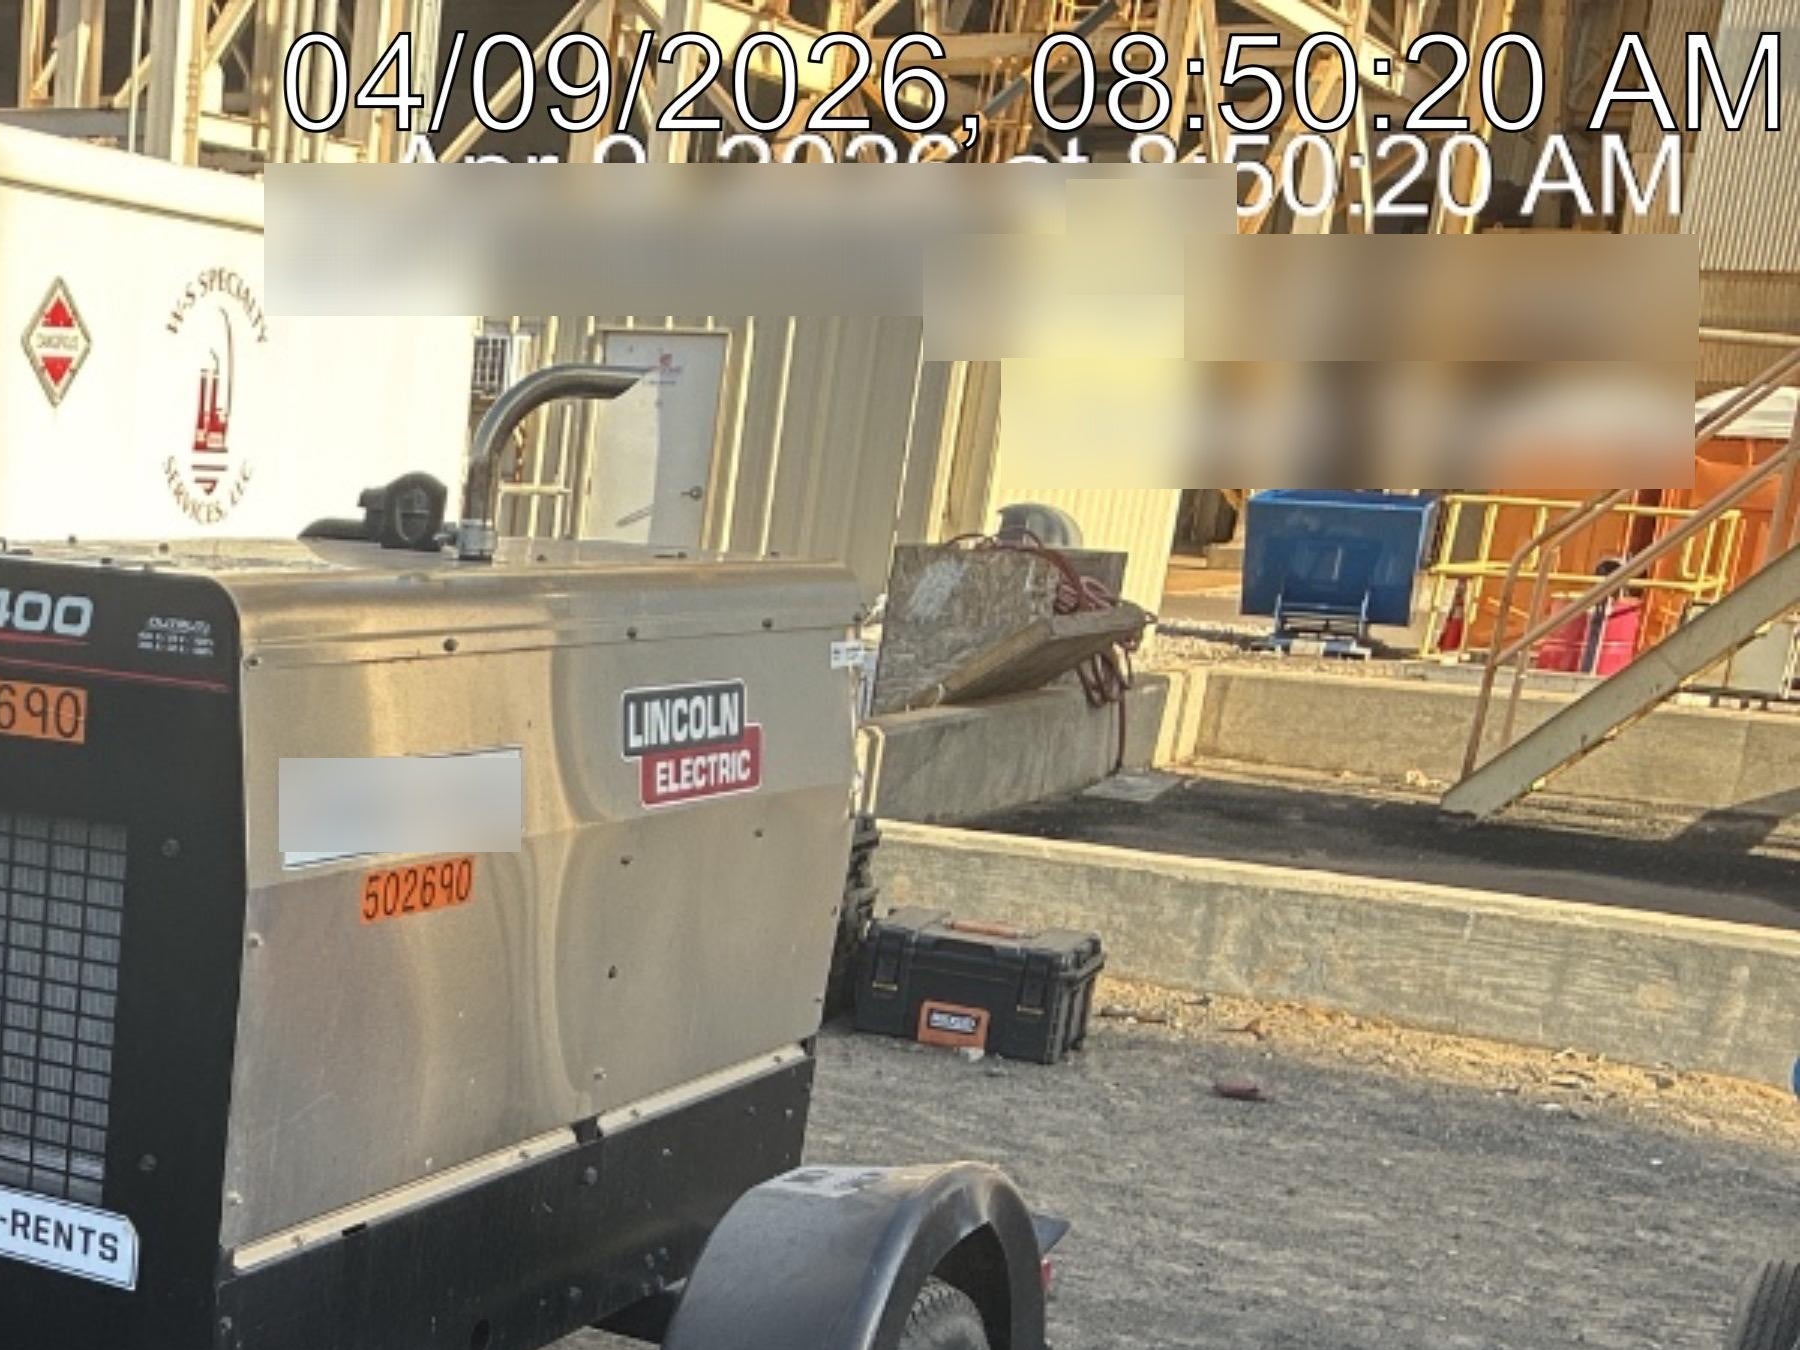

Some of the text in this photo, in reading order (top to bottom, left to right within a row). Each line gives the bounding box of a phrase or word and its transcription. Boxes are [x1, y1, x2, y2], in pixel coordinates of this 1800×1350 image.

[198, 267, 268, 343] SPECIALTY
[628, 691, 740, 749] LINCOLN
[655, 749, 751, 795] ELECTRIC
[363, 858, 472, 920] 502690
